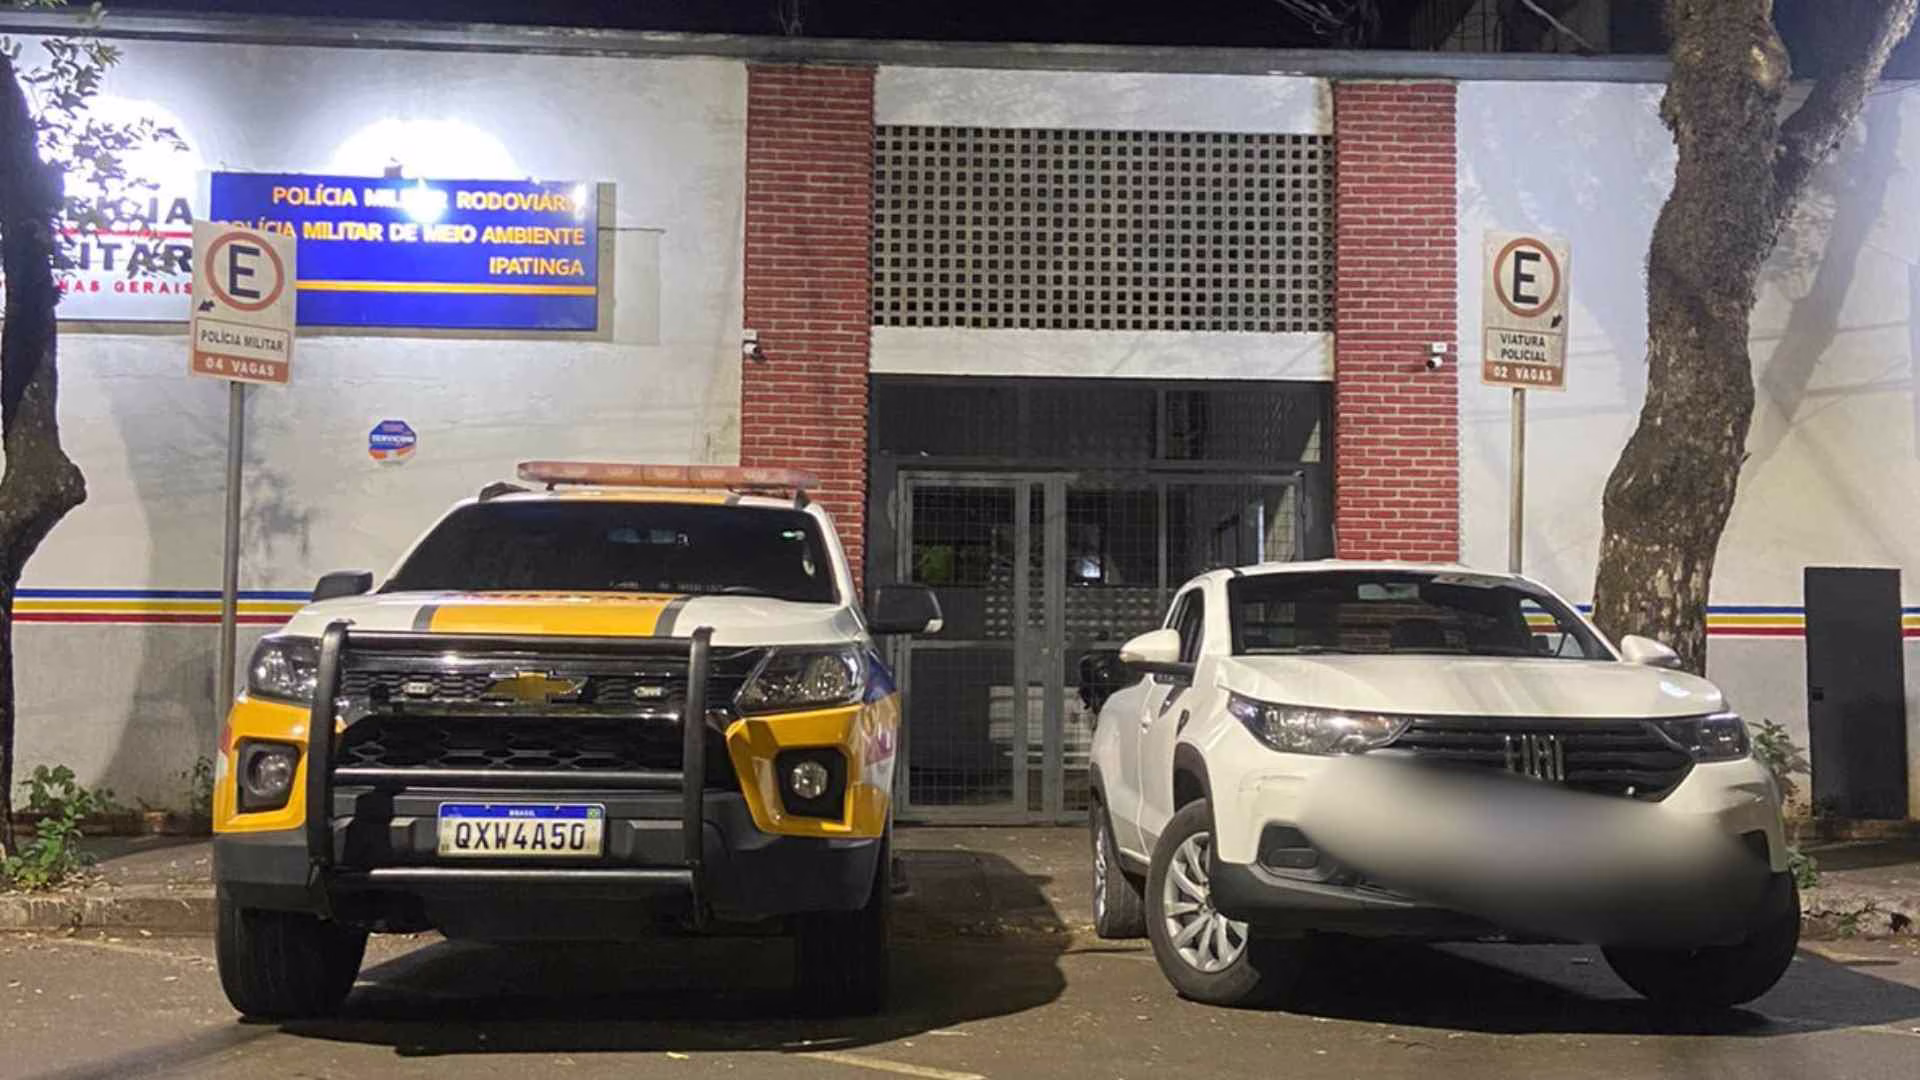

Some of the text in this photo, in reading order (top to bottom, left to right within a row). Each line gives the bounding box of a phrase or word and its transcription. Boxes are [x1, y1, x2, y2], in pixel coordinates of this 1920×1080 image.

[272, 184, 358, 207] POLÍCIA
[302, 221, 384, 241] MILITAR
[389, 223, 418, 243] DE
[481, 225, 586, 246] AMBIENTE
[229, 243, 261, 299] E
[489, 255, 585, 277] IPATINGA
[1513, 250, 1541, 305] E
[114, 281, 192, 296] GERAIS
[243, 336, 285, 352] MILITAR
[1500, 333, 1546, 347] VIATURA
[1500, 348, 1547, 362] POLICIAL
[205, 356, 276, 377] 04 VAGAS
[1493, 365, 1553, 382] 02 VAGAS
[455, 821, 586, 850] QXW4A50
